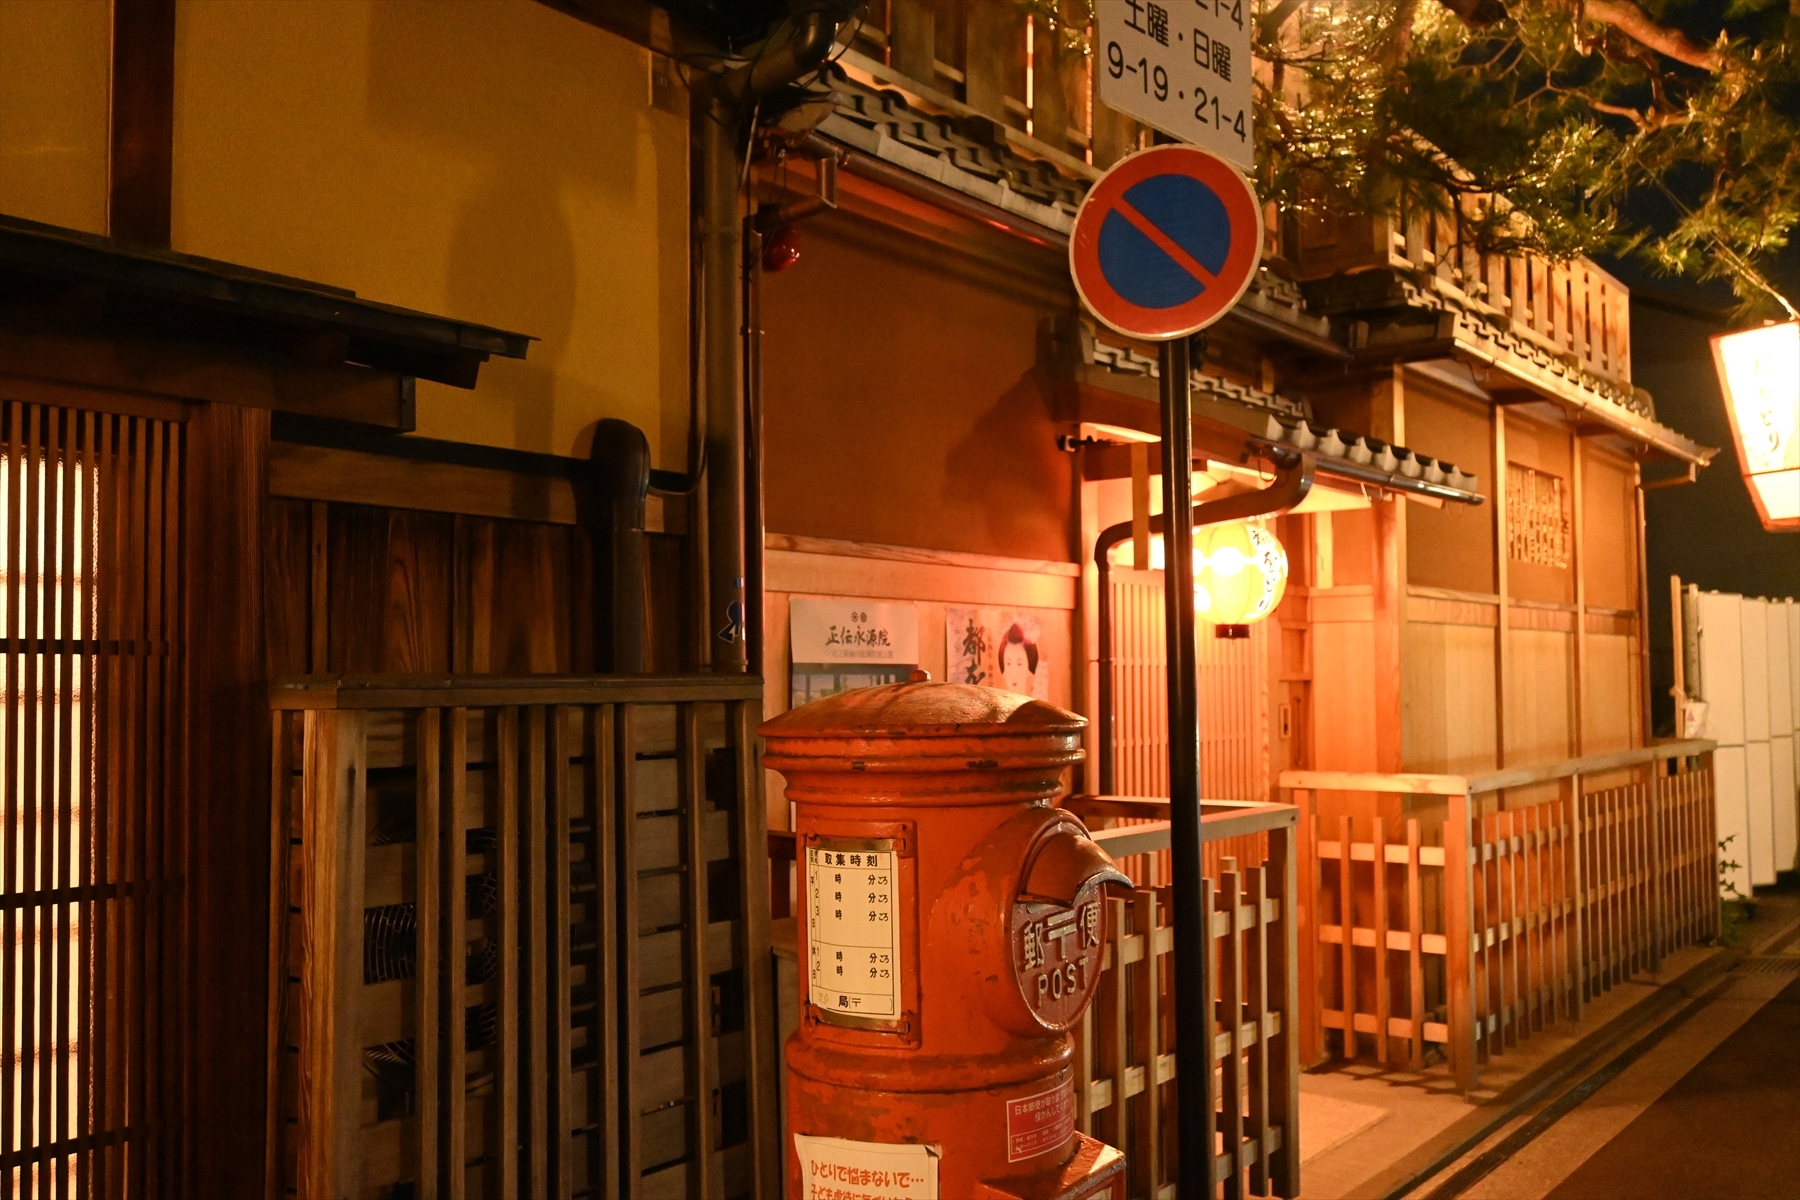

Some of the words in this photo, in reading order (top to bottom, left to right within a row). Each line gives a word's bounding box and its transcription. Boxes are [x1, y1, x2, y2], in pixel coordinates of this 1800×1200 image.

[1195, 0, 1244, 31] 1-4
[824, 852, 878, 867] 取集時刻
[834, 873, 842, 885] 時
[835, 891, 842, 903] 時
[835, 909, 842, 921] 時
[836, 951, 843, 962] 時
[836, 965, 843, 977] 時
[1037, 957, 1089, 1008] POST
